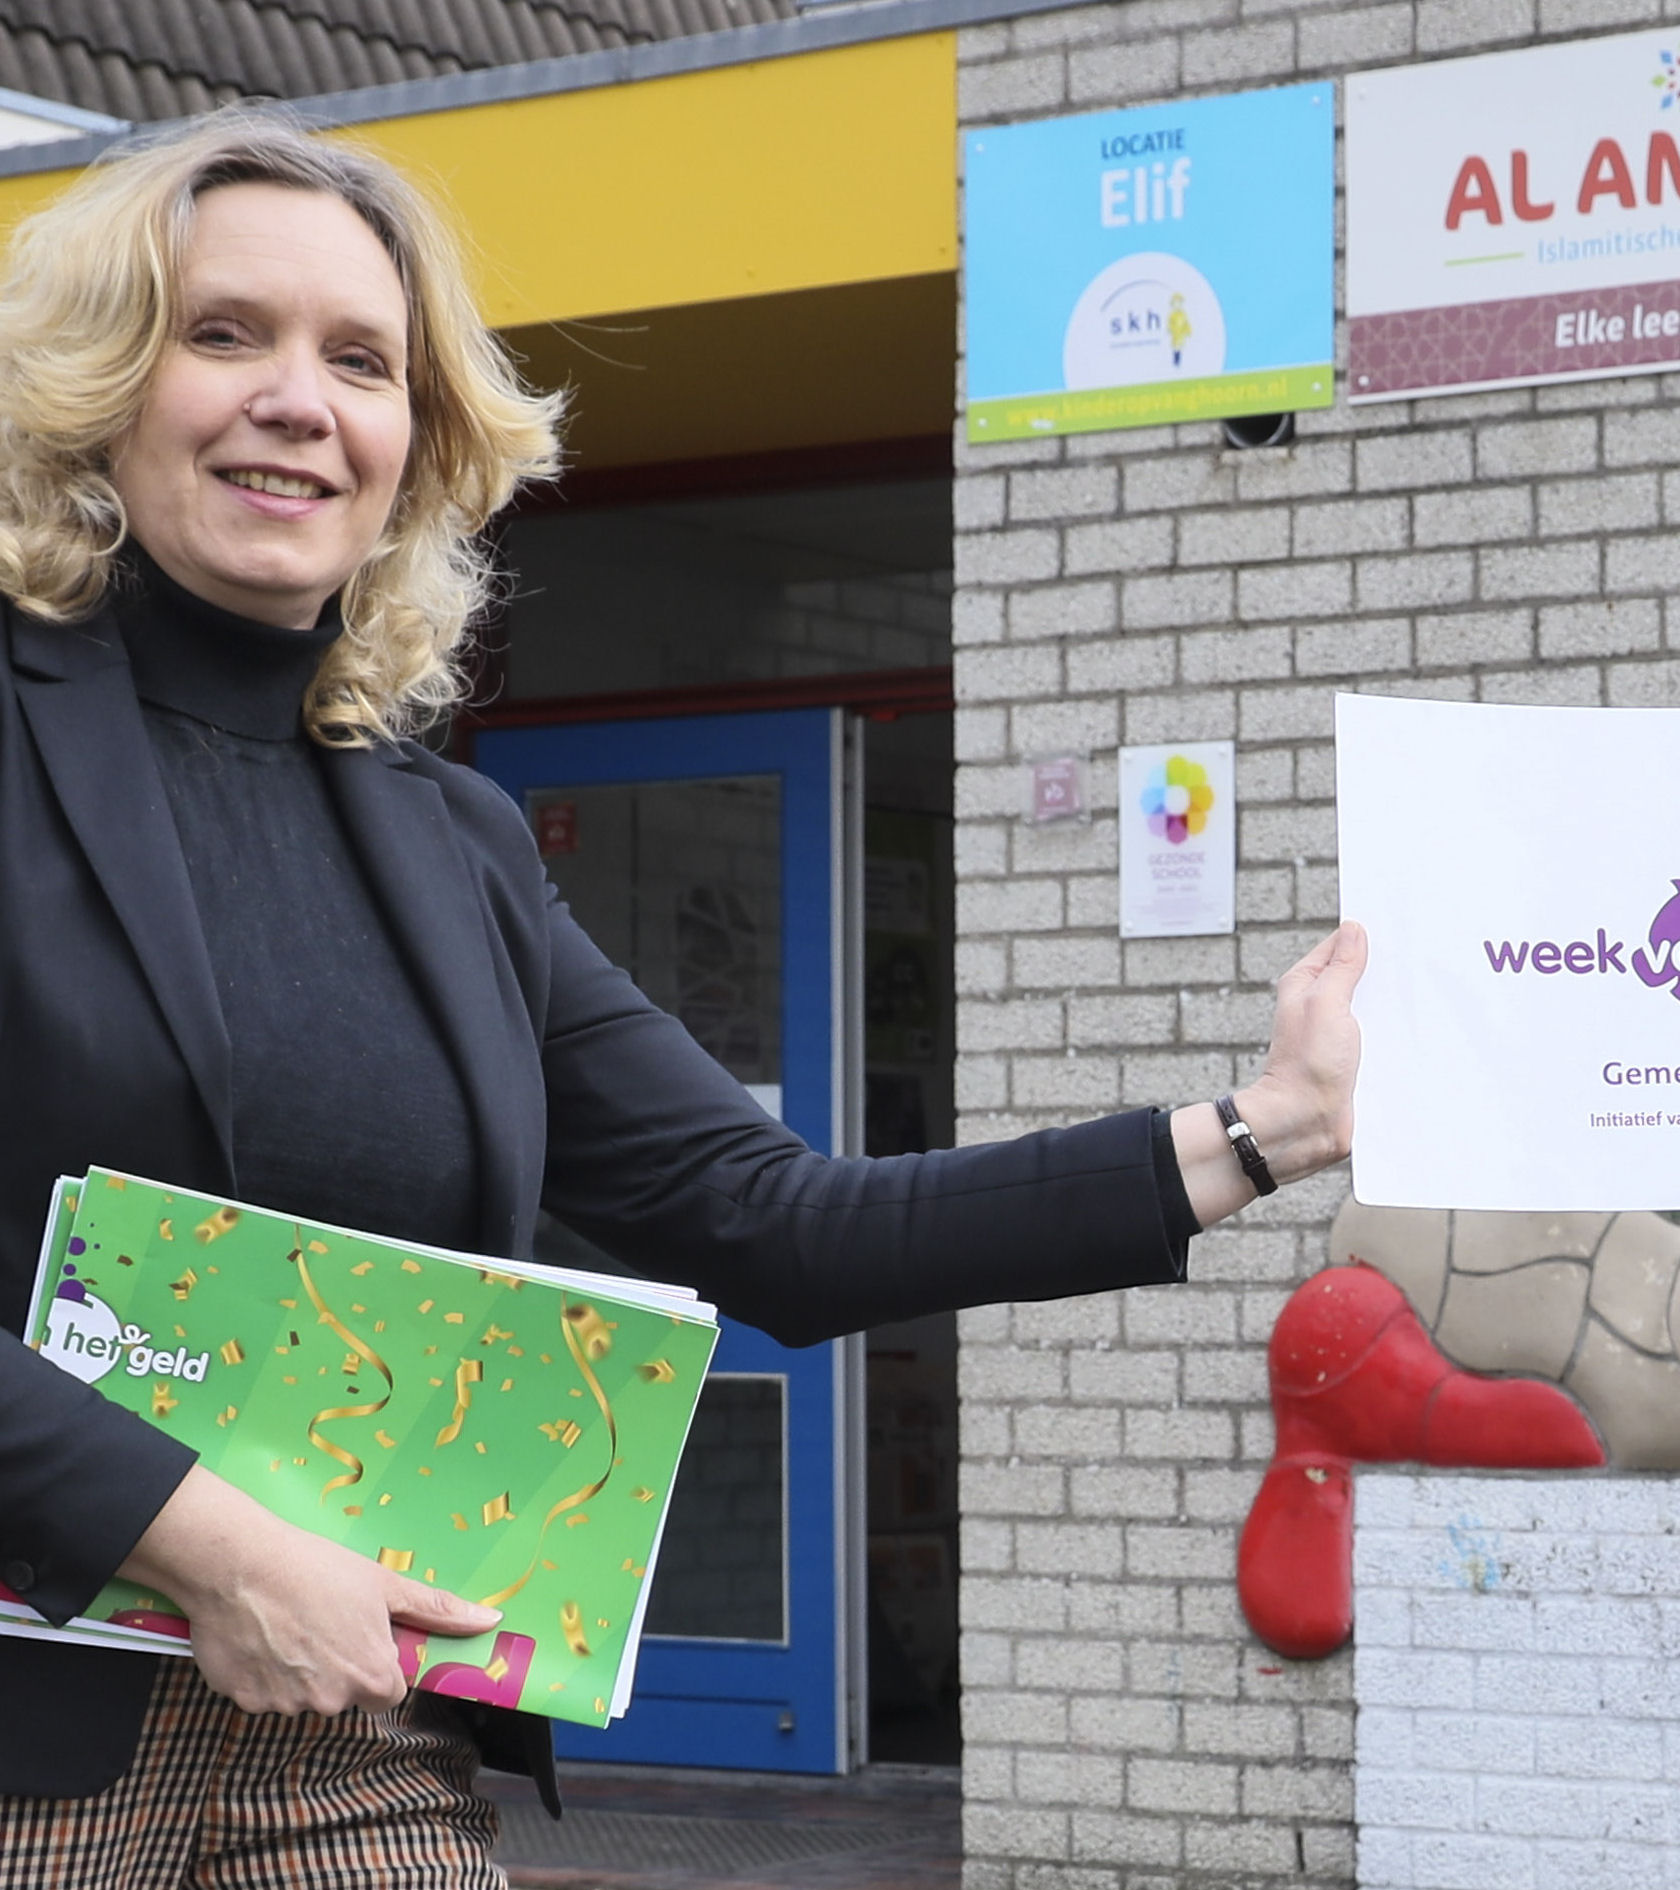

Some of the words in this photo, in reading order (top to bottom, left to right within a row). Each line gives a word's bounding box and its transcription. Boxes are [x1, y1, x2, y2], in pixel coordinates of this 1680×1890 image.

[1101, 128, 1186, 160] LOCATIE
[1100, 156, 1191, 228] Elif
[1445, 150, 1555, 231] AL
[1554, 308, 1626, 348] Elke
[1484, 928, 1627, 974] week
[1590, 1112, 1663, 1128] Initiatief
[63, 1322, 121, 1361] het
[126, 1345, 210, 1383] geld
